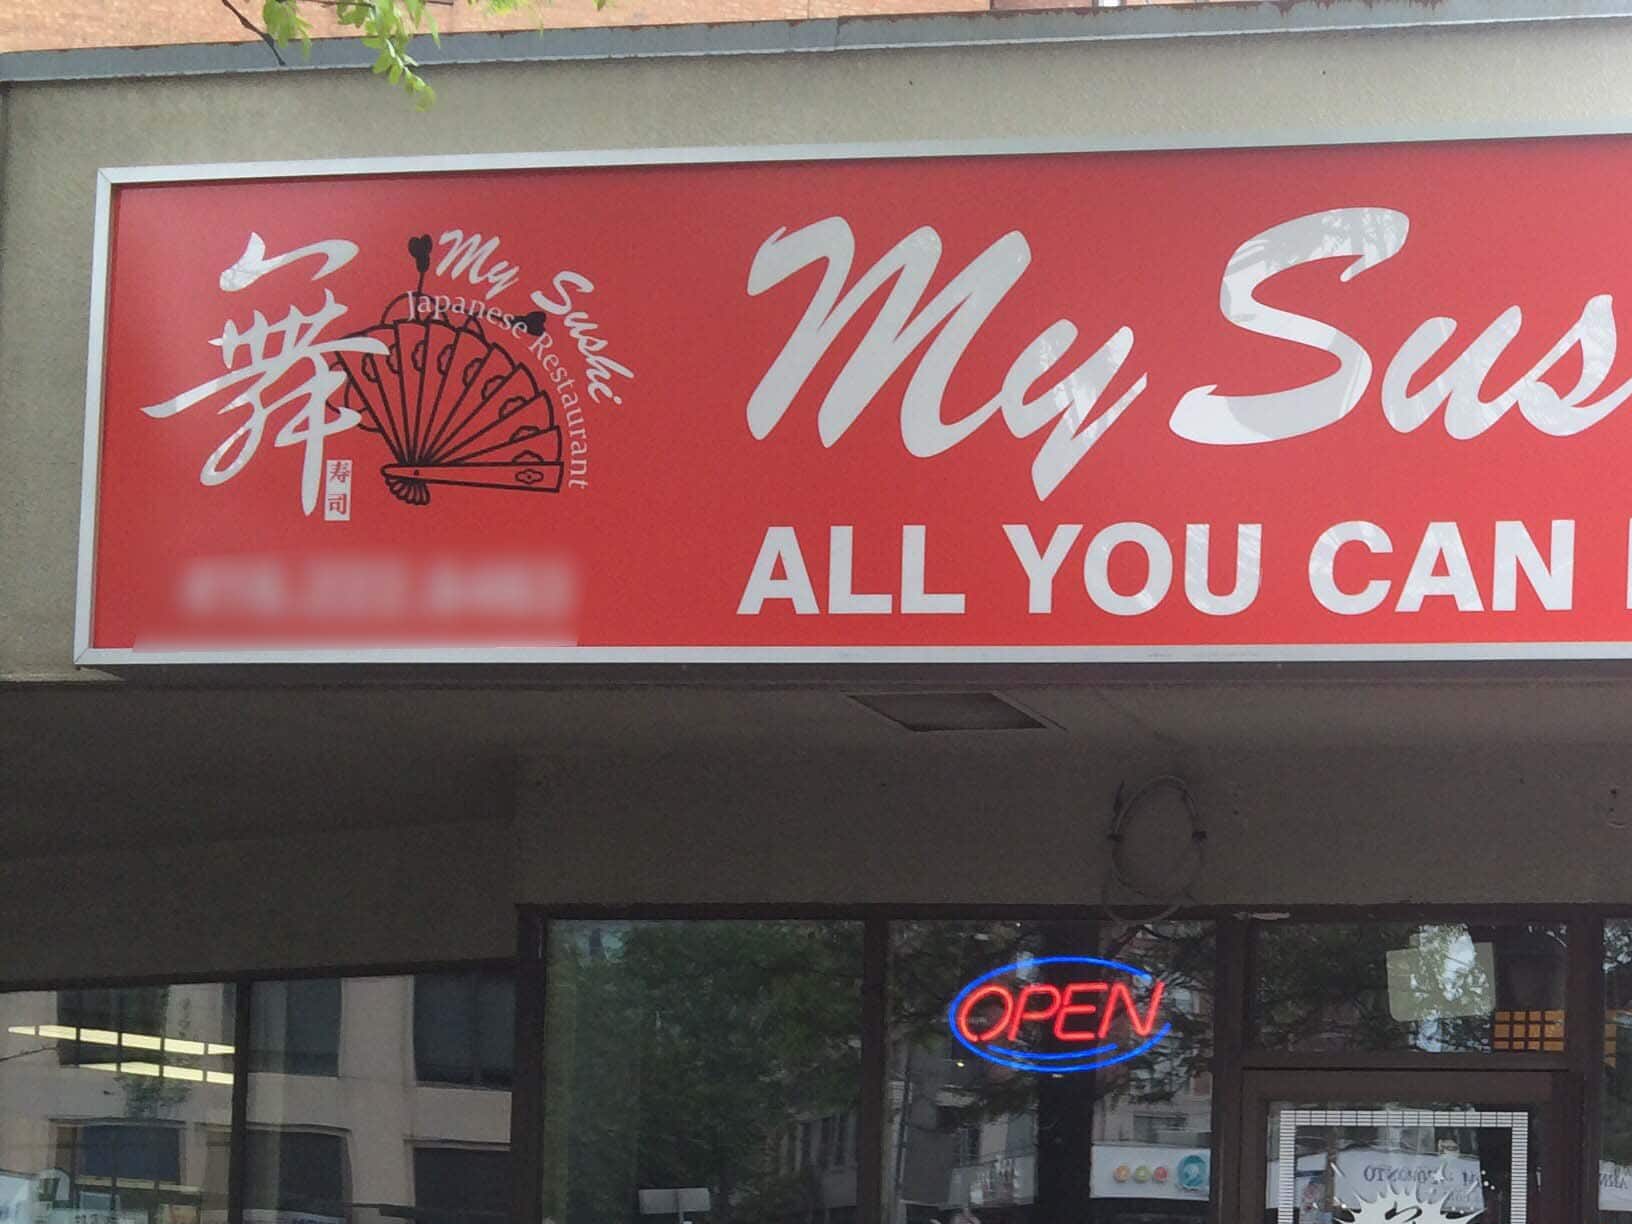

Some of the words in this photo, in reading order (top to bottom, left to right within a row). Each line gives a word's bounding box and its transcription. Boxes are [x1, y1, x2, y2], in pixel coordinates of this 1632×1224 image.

[435, 229, 519, 300] My
[530, 270, 635, 405] Sushi
[746, 215, 1147, 501] My
[407, 289, 528, 340] Japanese
[528, 331, 589, 489] Restaurant
[328, 460, 349, 515] 寿司
[737, 524, 966, 615] ALL
[1003, 521, 1262, 616] YOU
[1308, 520, 1575, 615] CAN
[956, 980, 1166, 1042] OPEN
